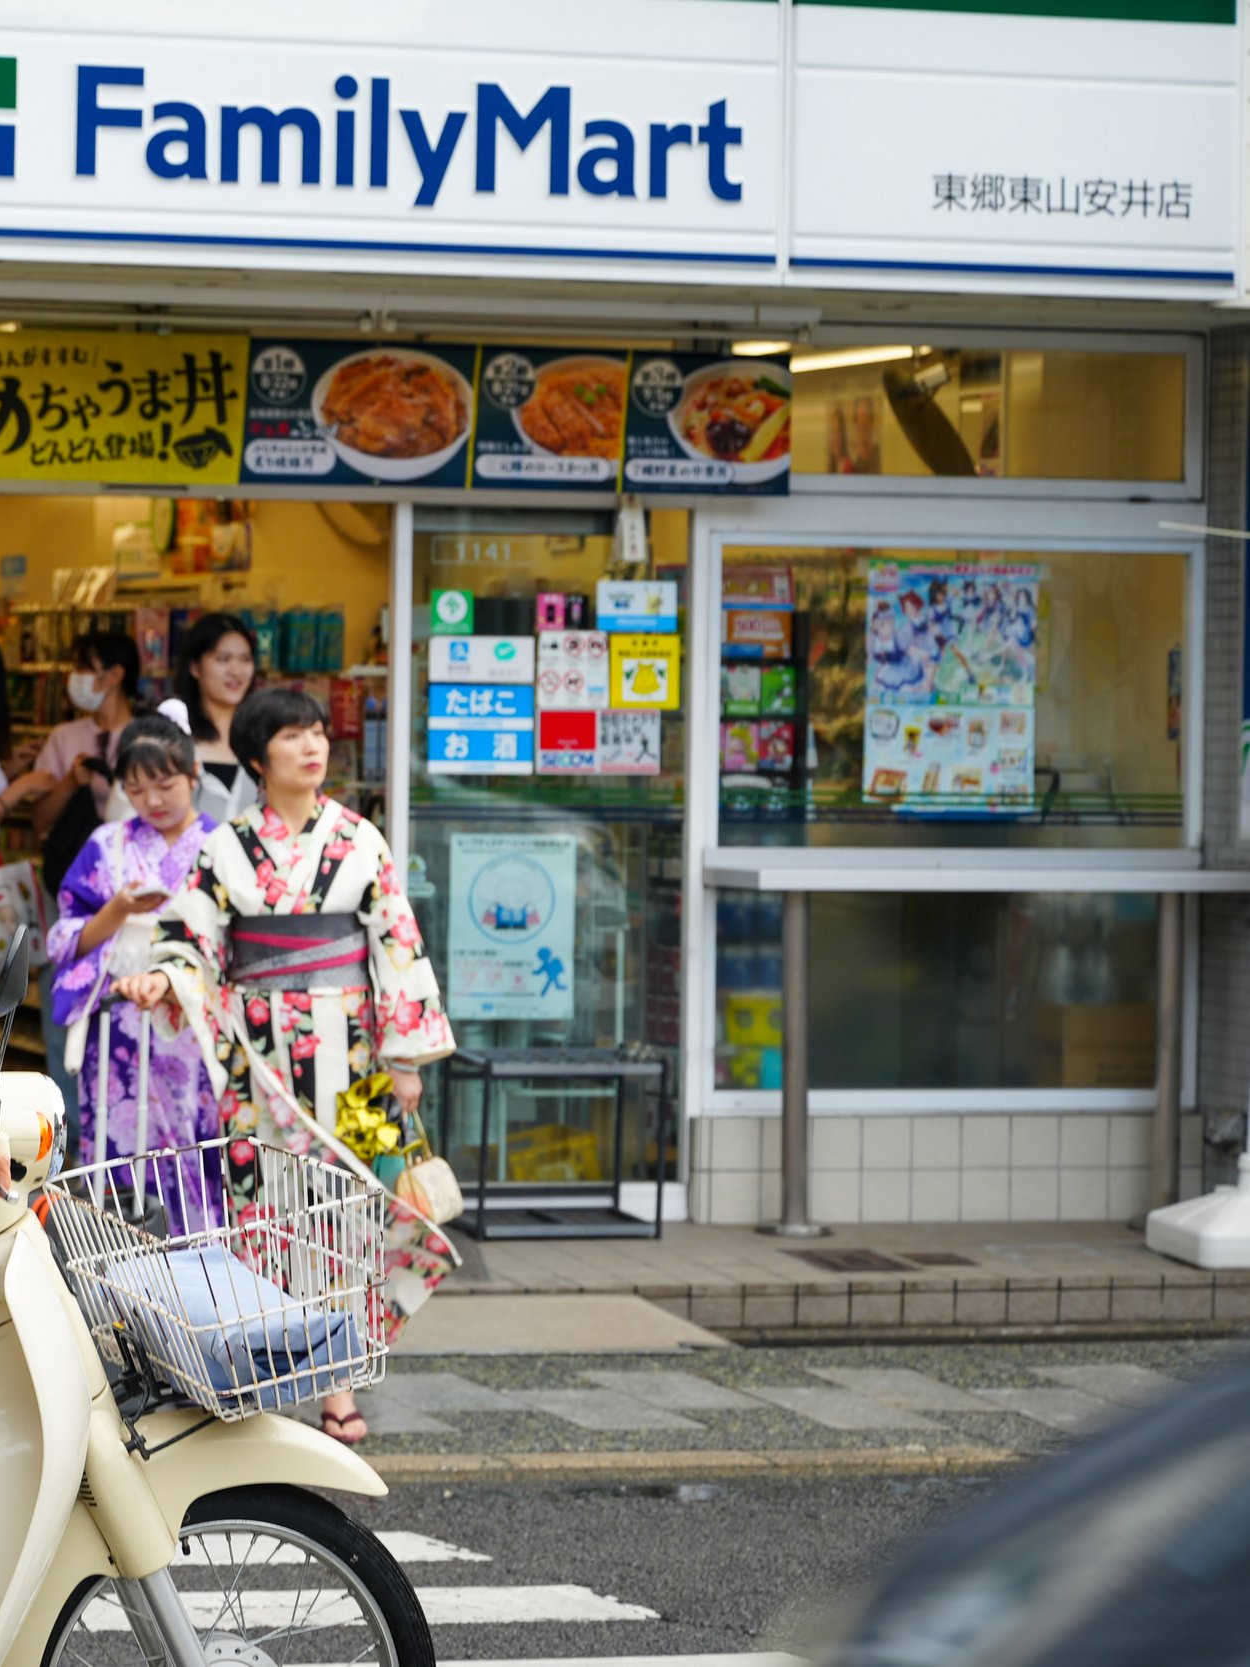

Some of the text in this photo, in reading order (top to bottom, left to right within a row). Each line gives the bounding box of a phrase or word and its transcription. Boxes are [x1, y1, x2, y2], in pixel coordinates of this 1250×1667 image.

[76, 64, 743, 207] FamilyMart
[931, 172, 1193, 220] 東郷東山安井店
[445, 688, 517, 716] たばこ
